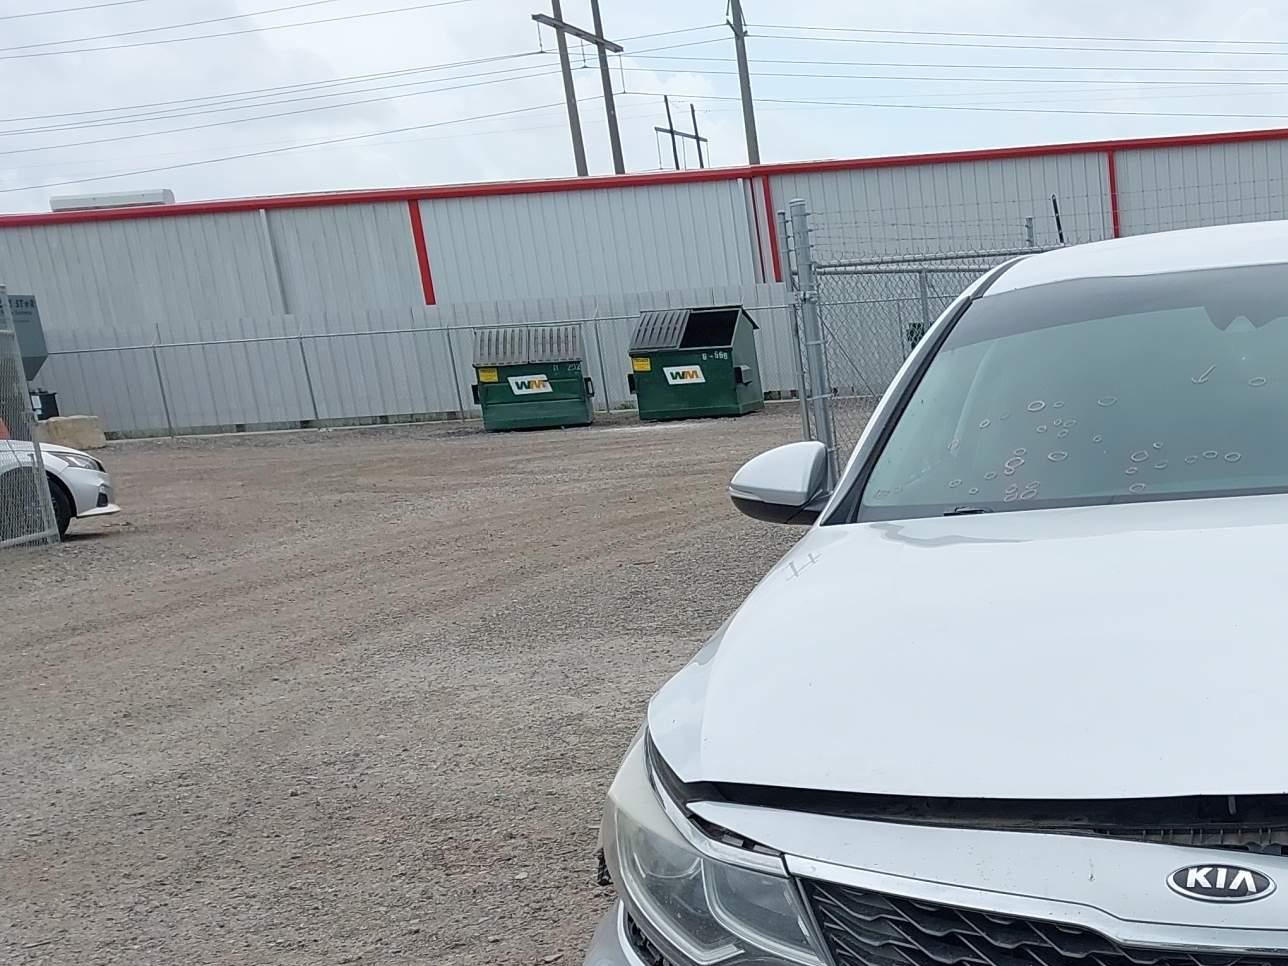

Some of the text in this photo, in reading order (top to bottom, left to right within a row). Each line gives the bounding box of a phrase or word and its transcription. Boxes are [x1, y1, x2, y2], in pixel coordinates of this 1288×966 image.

[670, 370, 700, 380] WM
[515, 380, 546, 390] WM
[1186, 867, 1257, 893] KIA
